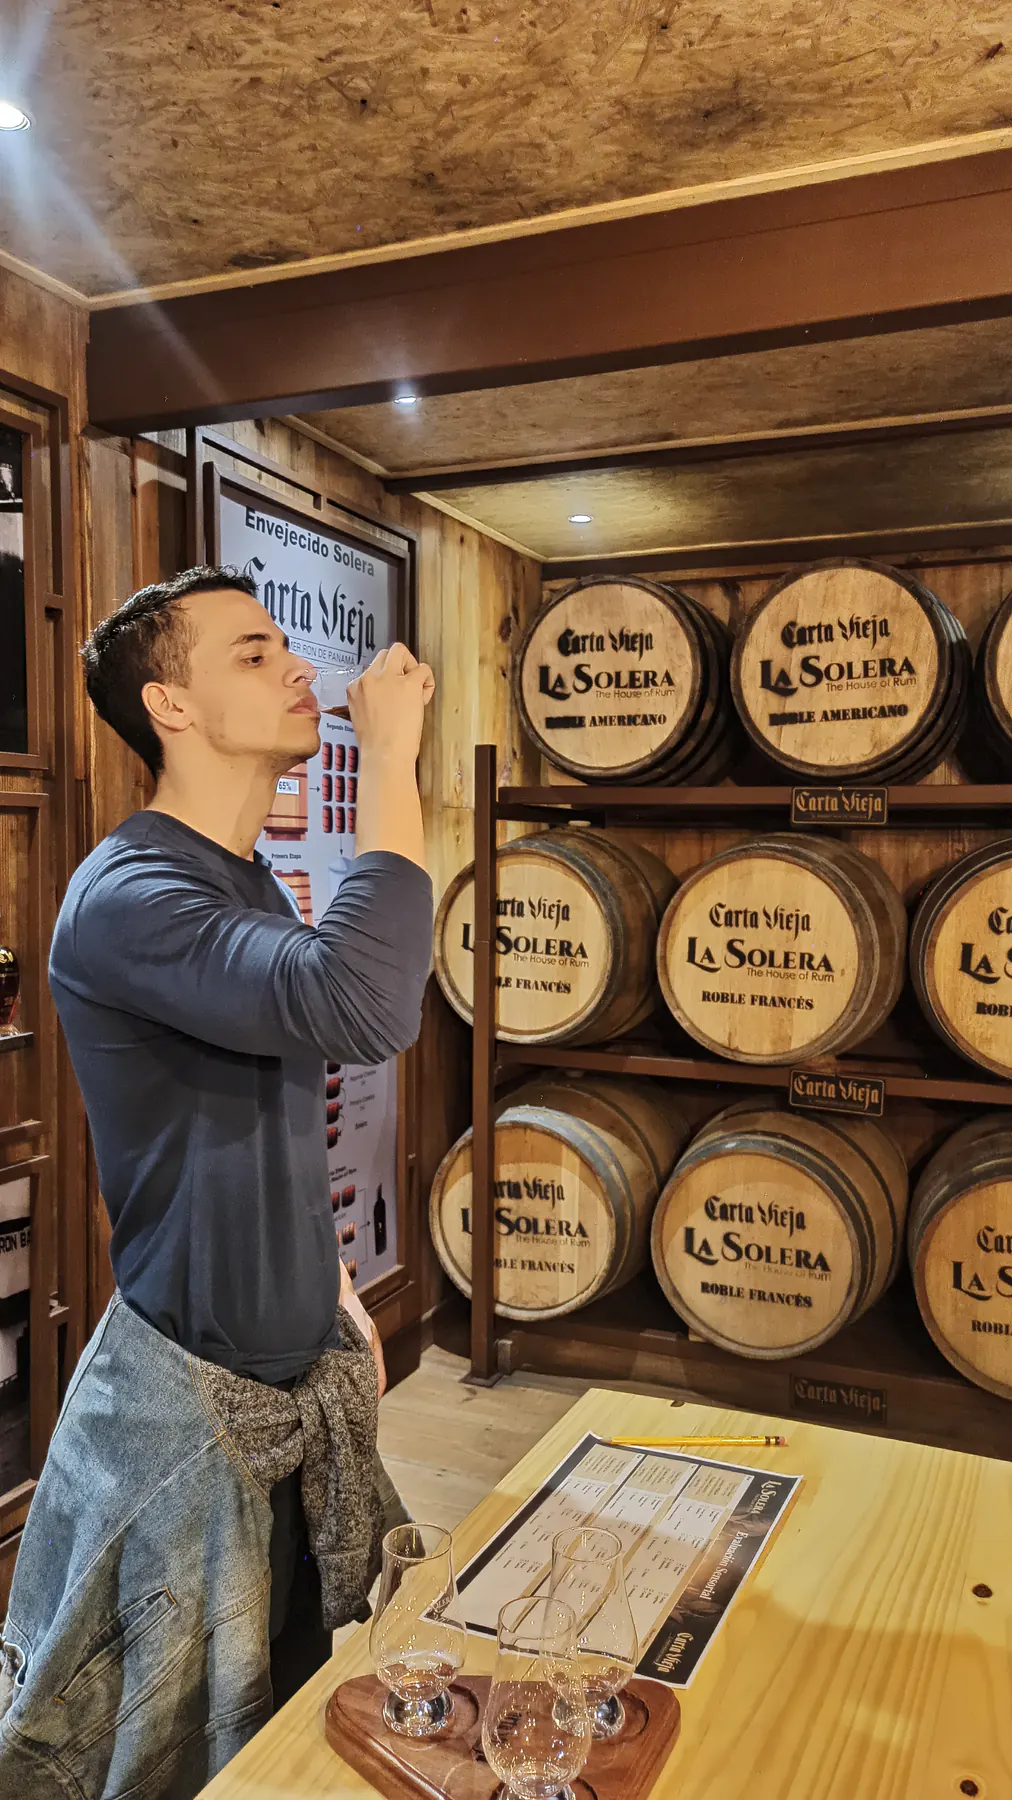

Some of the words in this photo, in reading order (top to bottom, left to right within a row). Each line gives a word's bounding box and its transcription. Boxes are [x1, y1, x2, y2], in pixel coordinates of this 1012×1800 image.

[245, 506, 329, 558] Envejecido
[333, 544, 375, 577] Solera
[318, 580, 376, 665] Vieja
[780, 620, 834, 649] Carta
[838, 612, 890, 650] Vieja
[302, 644, 317, 658] RON
[318, 649, 327, 660] DE
[557, 628, 605, 657] Carta
[538, 665, 572, 701] LA
[573, 663, 675, 694] SOLERA
[595, 690, 611, 698] The
[614, 690, 642, 698] House
[644, 688, 654, 698] of
[655, 688, 676, 697] Rum
[759, 660, 798, 697] LA
[799, 654, 917, 688] SOLERA
[825, 682, 844, 692] The
[846, 680, 877, 690] House
[880, 679, 890, 688] of
[893, 676, 917, 687] Rum
[589, 713, 667, 727] AMERICANO
[820, 704, 909, 722] AMERICANO
[796, 791, 839, 812] Carta
[841, 791, 883, 820] Vieja
[528, 895, 570, 931] Vieja
[709, 902, 758, 930] Carta
[763, 904, 812, 942] Vieja
[496, 925, 588, 959] SOLERA
[686, 936, 721, 974] LA
[724, 938, 834, 973] SOLERA
[513, 953, 528, 962] The
[530, 955, 557, 966] House
[559, 957, 568, 967] of
[569, 957, 590, 968] Rum
[746, 967, 764, 977] The
[766, 969, 796, 981] House
[799, 970, 809, 981] of
[811, 972, 835, 983] Rum
[959, 942, 1001, 985] LA
[701, 990, 746, 1005] ROBLE
[750, 994, 814, 1010] FRANCÉS
[793, 1075, 836, 1099] Carta
[839, 1080, 880, 1111] Vieja
[495, 1207, 589, 1238] SOLERA
[704, 1195, 755, 1224] Carta
[758, 1199, 807, 1237] Vieja
[684, 1227, 720, 1266] LA
[721, 1232, 832, 1273] SOLERA
[701, 1281, 745, 1298] ROBLE
[951, 1260, 993, 1301] LA
[751, 1489, 777, 1514] SOLERA
[719, 1531, 749, 1567] Evaluación
[699, 1566, 728, 1601] Sensorial
